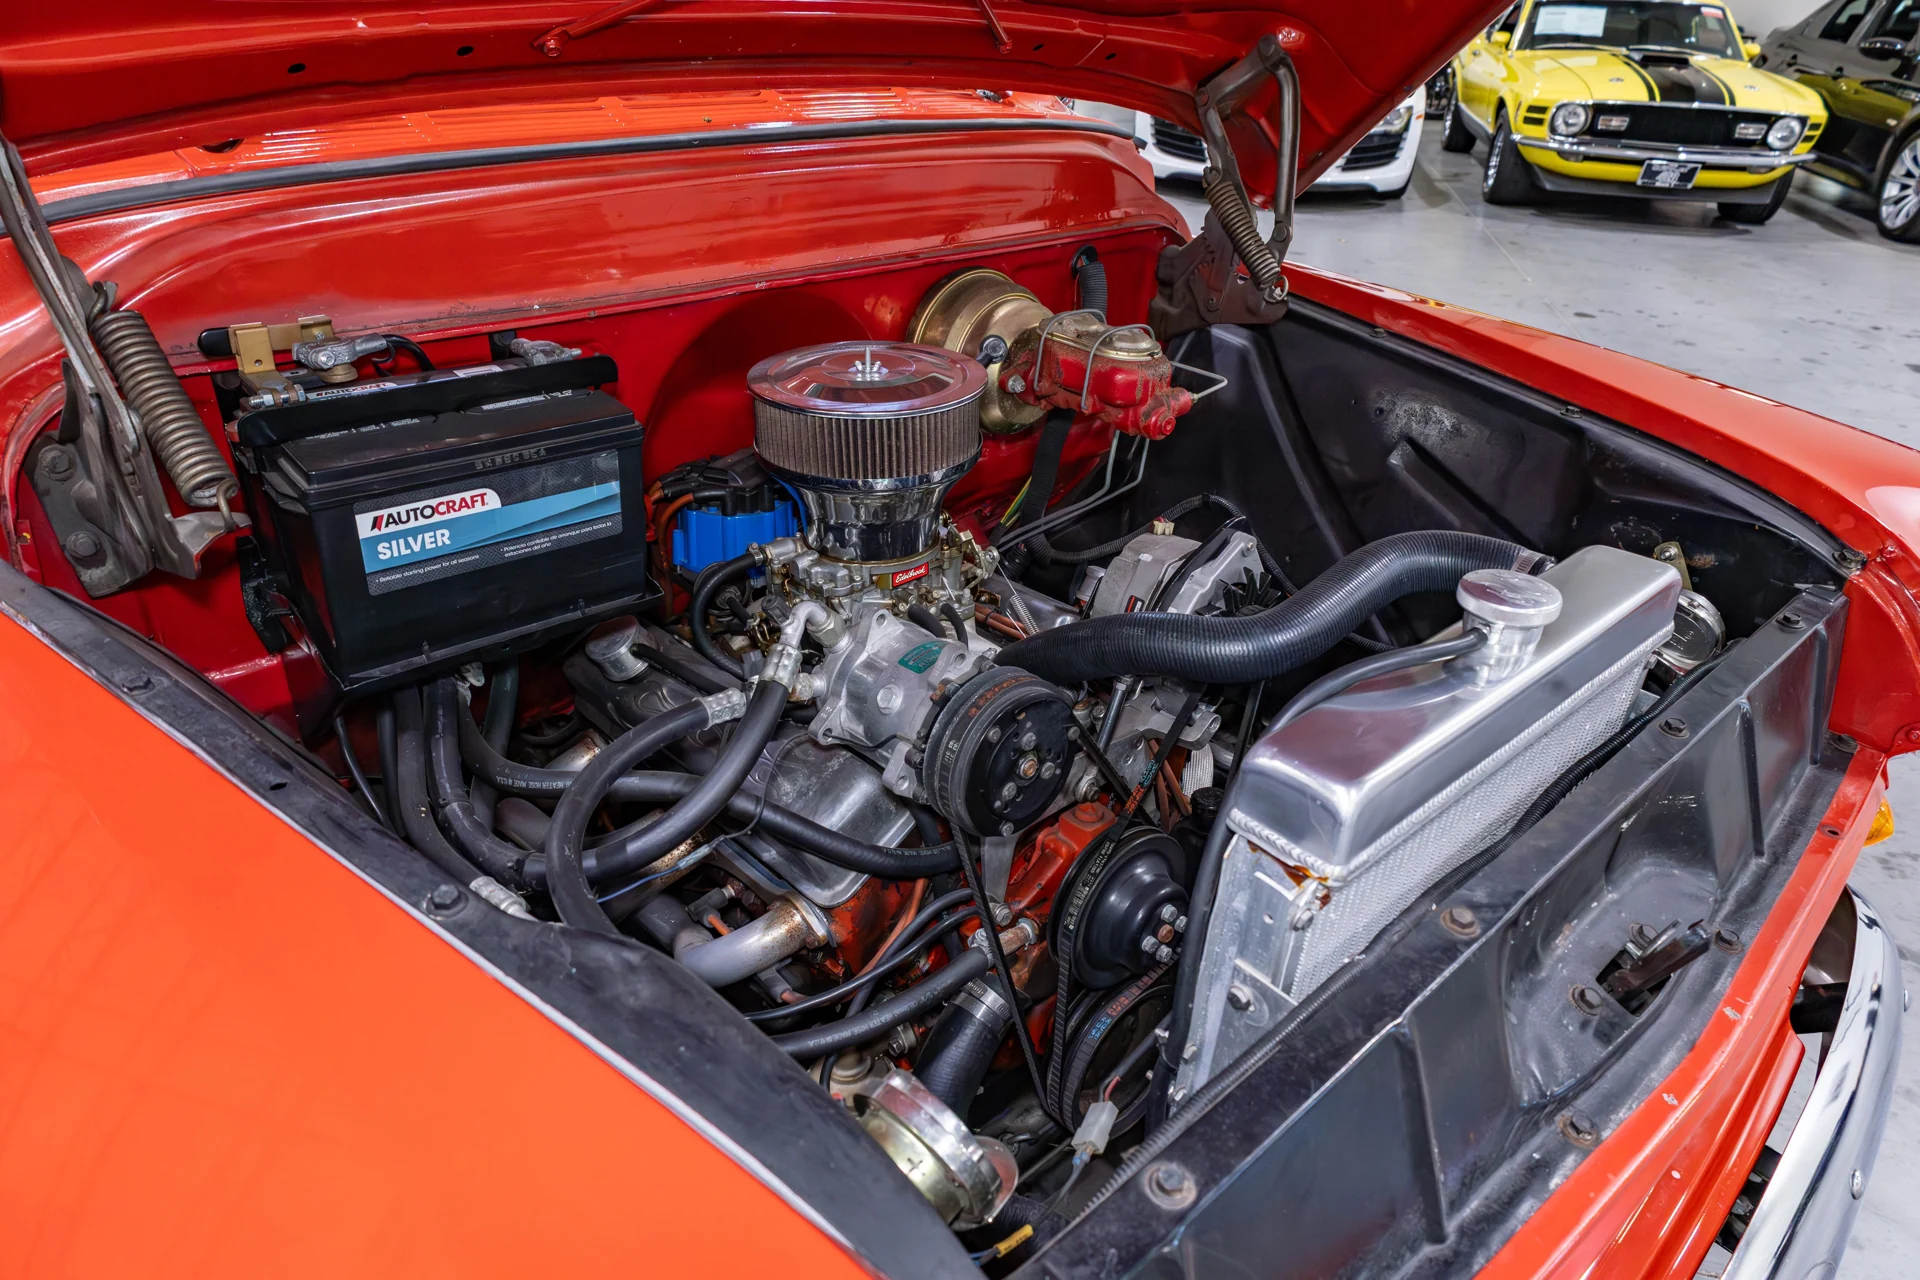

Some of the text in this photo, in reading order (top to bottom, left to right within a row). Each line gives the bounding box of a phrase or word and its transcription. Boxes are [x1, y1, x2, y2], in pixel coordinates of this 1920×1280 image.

[384, 492, 488, 529] AUTOCRAFT
[377, 529, 451, 560] SILVER
[504, 543, 526, 552] Potencia
[581, 526, 593, 534] para
[504, 547, 532, 558] estaciones
[380, 573, 403, 583] Reliable
[403, 568, 424, 578] starting
[424, 564, 442, 573] power
[458, 554, 480, 563] seasons
[895, 566, 926, 583] Edelbrock
[542, 781, 564, 789] HEATER
